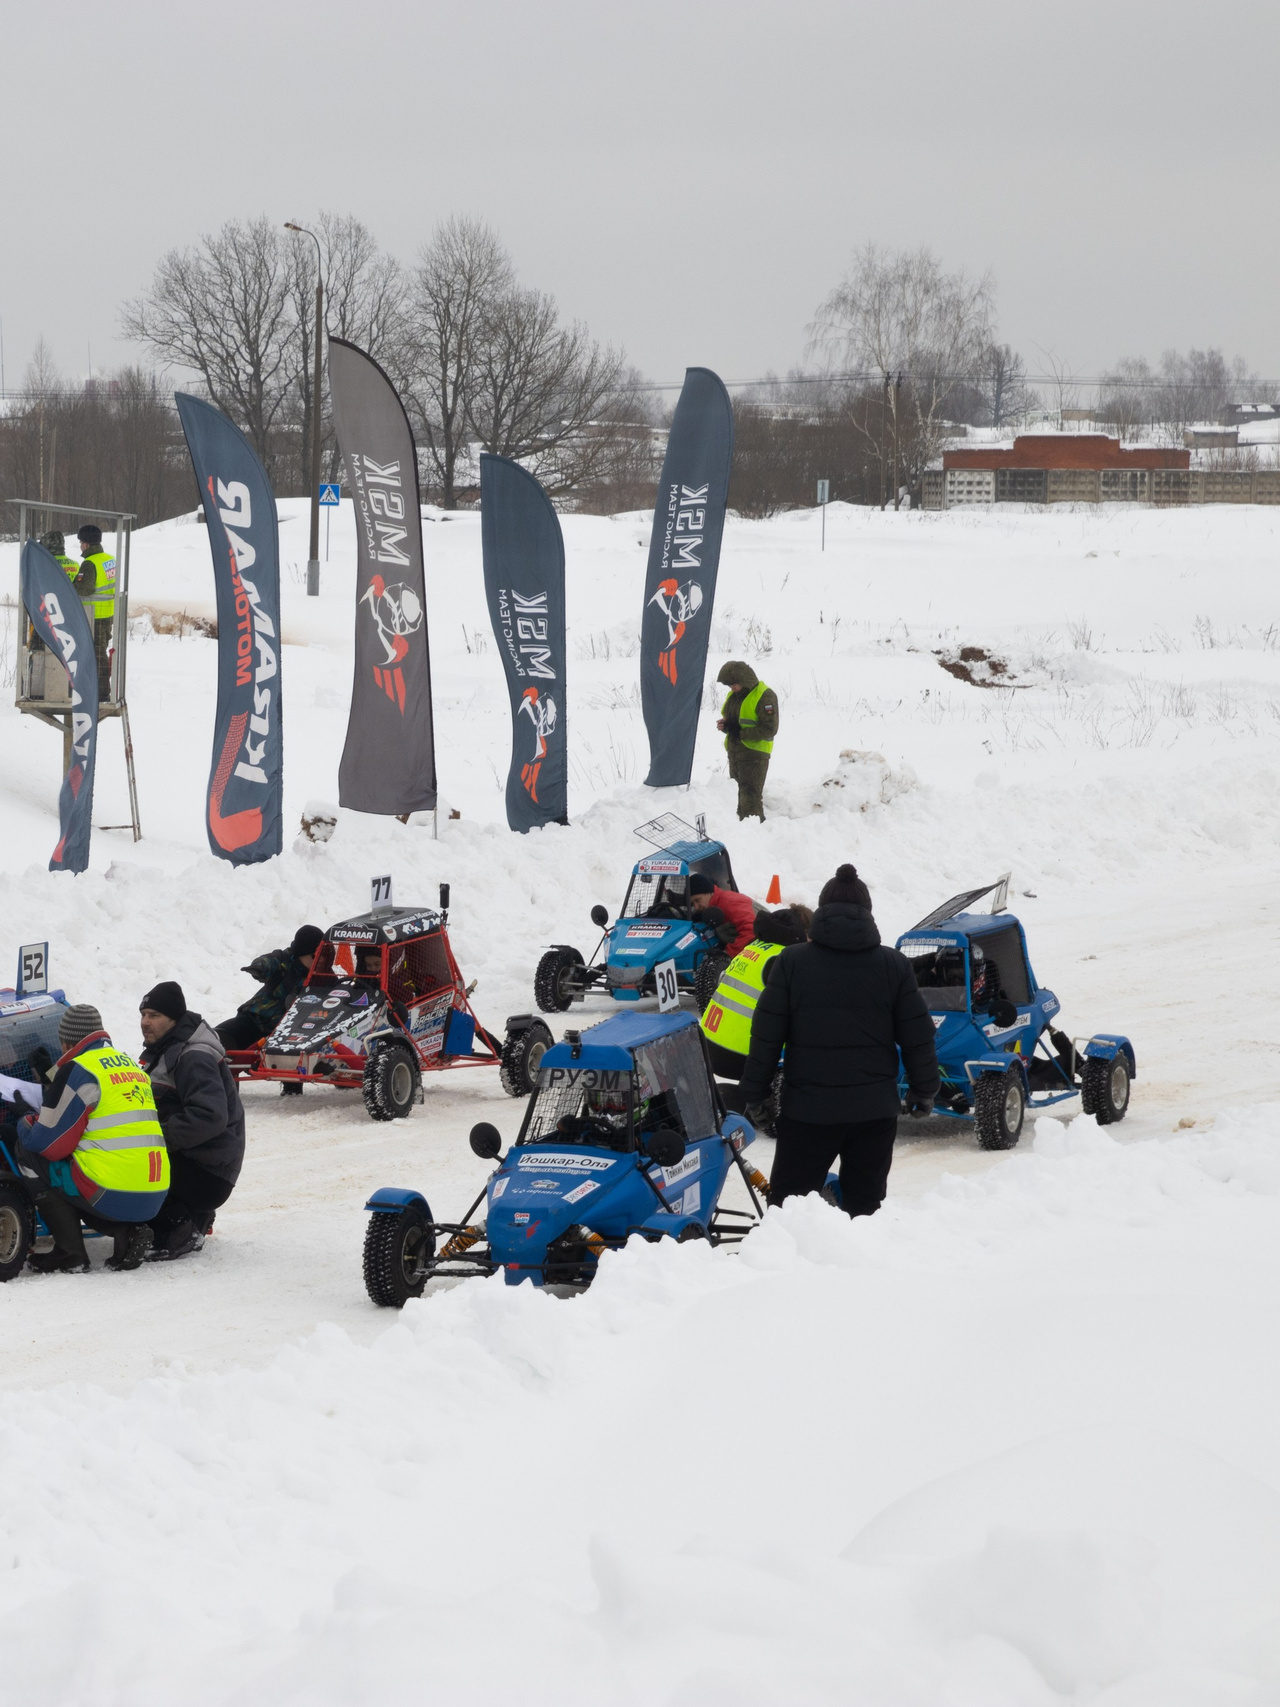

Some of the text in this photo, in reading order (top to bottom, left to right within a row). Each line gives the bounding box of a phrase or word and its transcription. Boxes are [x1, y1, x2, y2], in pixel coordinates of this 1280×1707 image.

[372, 876, 391, 901] 77
[334, 930, 373, 940] KRAMAR
[23, 952, 44, 981] 52
[658, 968, 676, 1005] 30
[704, 1004, 723, 1033] 10
[549, 1068, 620, 1089] РУЭМ
[519, 1155, 609, 1168] Йошкар-Ола
